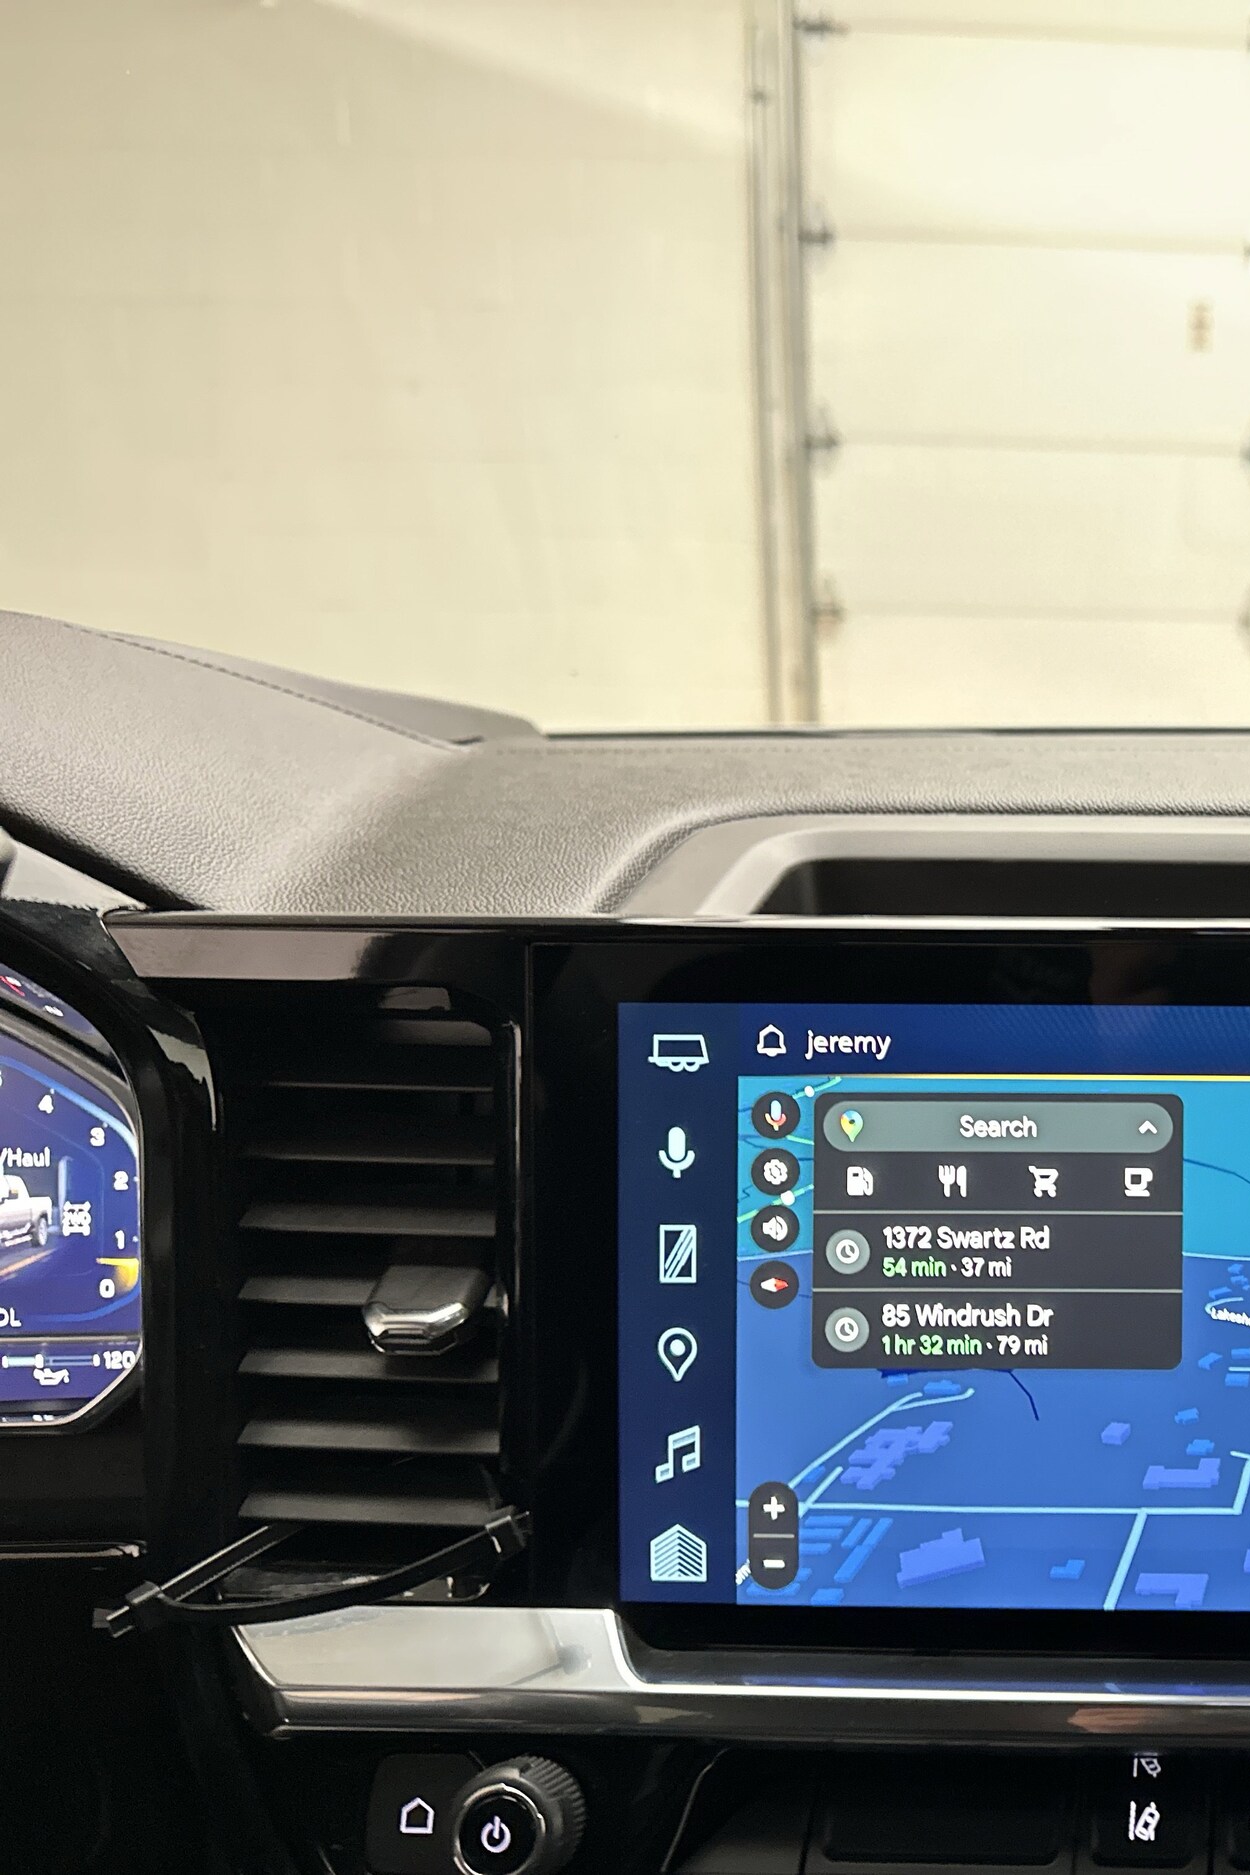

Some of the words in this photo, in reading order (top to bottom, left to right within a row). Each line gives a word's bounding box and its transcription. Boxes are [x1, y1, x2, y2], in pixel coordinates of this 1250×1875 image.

[805, 1030, 891, 1060] jeremy
[38, 1094, 54, 1114] 4
[959, 1114, 1038, 1138] Search
[89, 1127, 105, 1147] 3
[113, 1170, 129, 1190] 2
[114, 1230, 125, 1250] 1
[883, 1226, 932, 1249] 1372
[936, 1226, 1015, 1249] Swartz
[1020, 1225, 1050, 1249] Rd
[882, 1257, 907, 1277] 54
[911, 1256, 947, 1277] min
[961, 1257, 985, 1277] 37
[988, 1256, 1012, 1277] mi
[99, 1278, 115, 1298] 0
[881, 1303, 910, 1327] 85
[915, 1302, 1021, 1327] Windrush
[1026, 1304, 1054, 1327] Dr
[881, 1335, 891, 1355] 1
[894, 1334, 916, 1355] hr
[919, 1335, 943, 1355] 32
[947, 1334, 983, 1355] min
[996, 1335, 1021, 1355] 79
[1024, 1334, 1048, 1355] mi
[103, 1350, 136, 1369] 120
